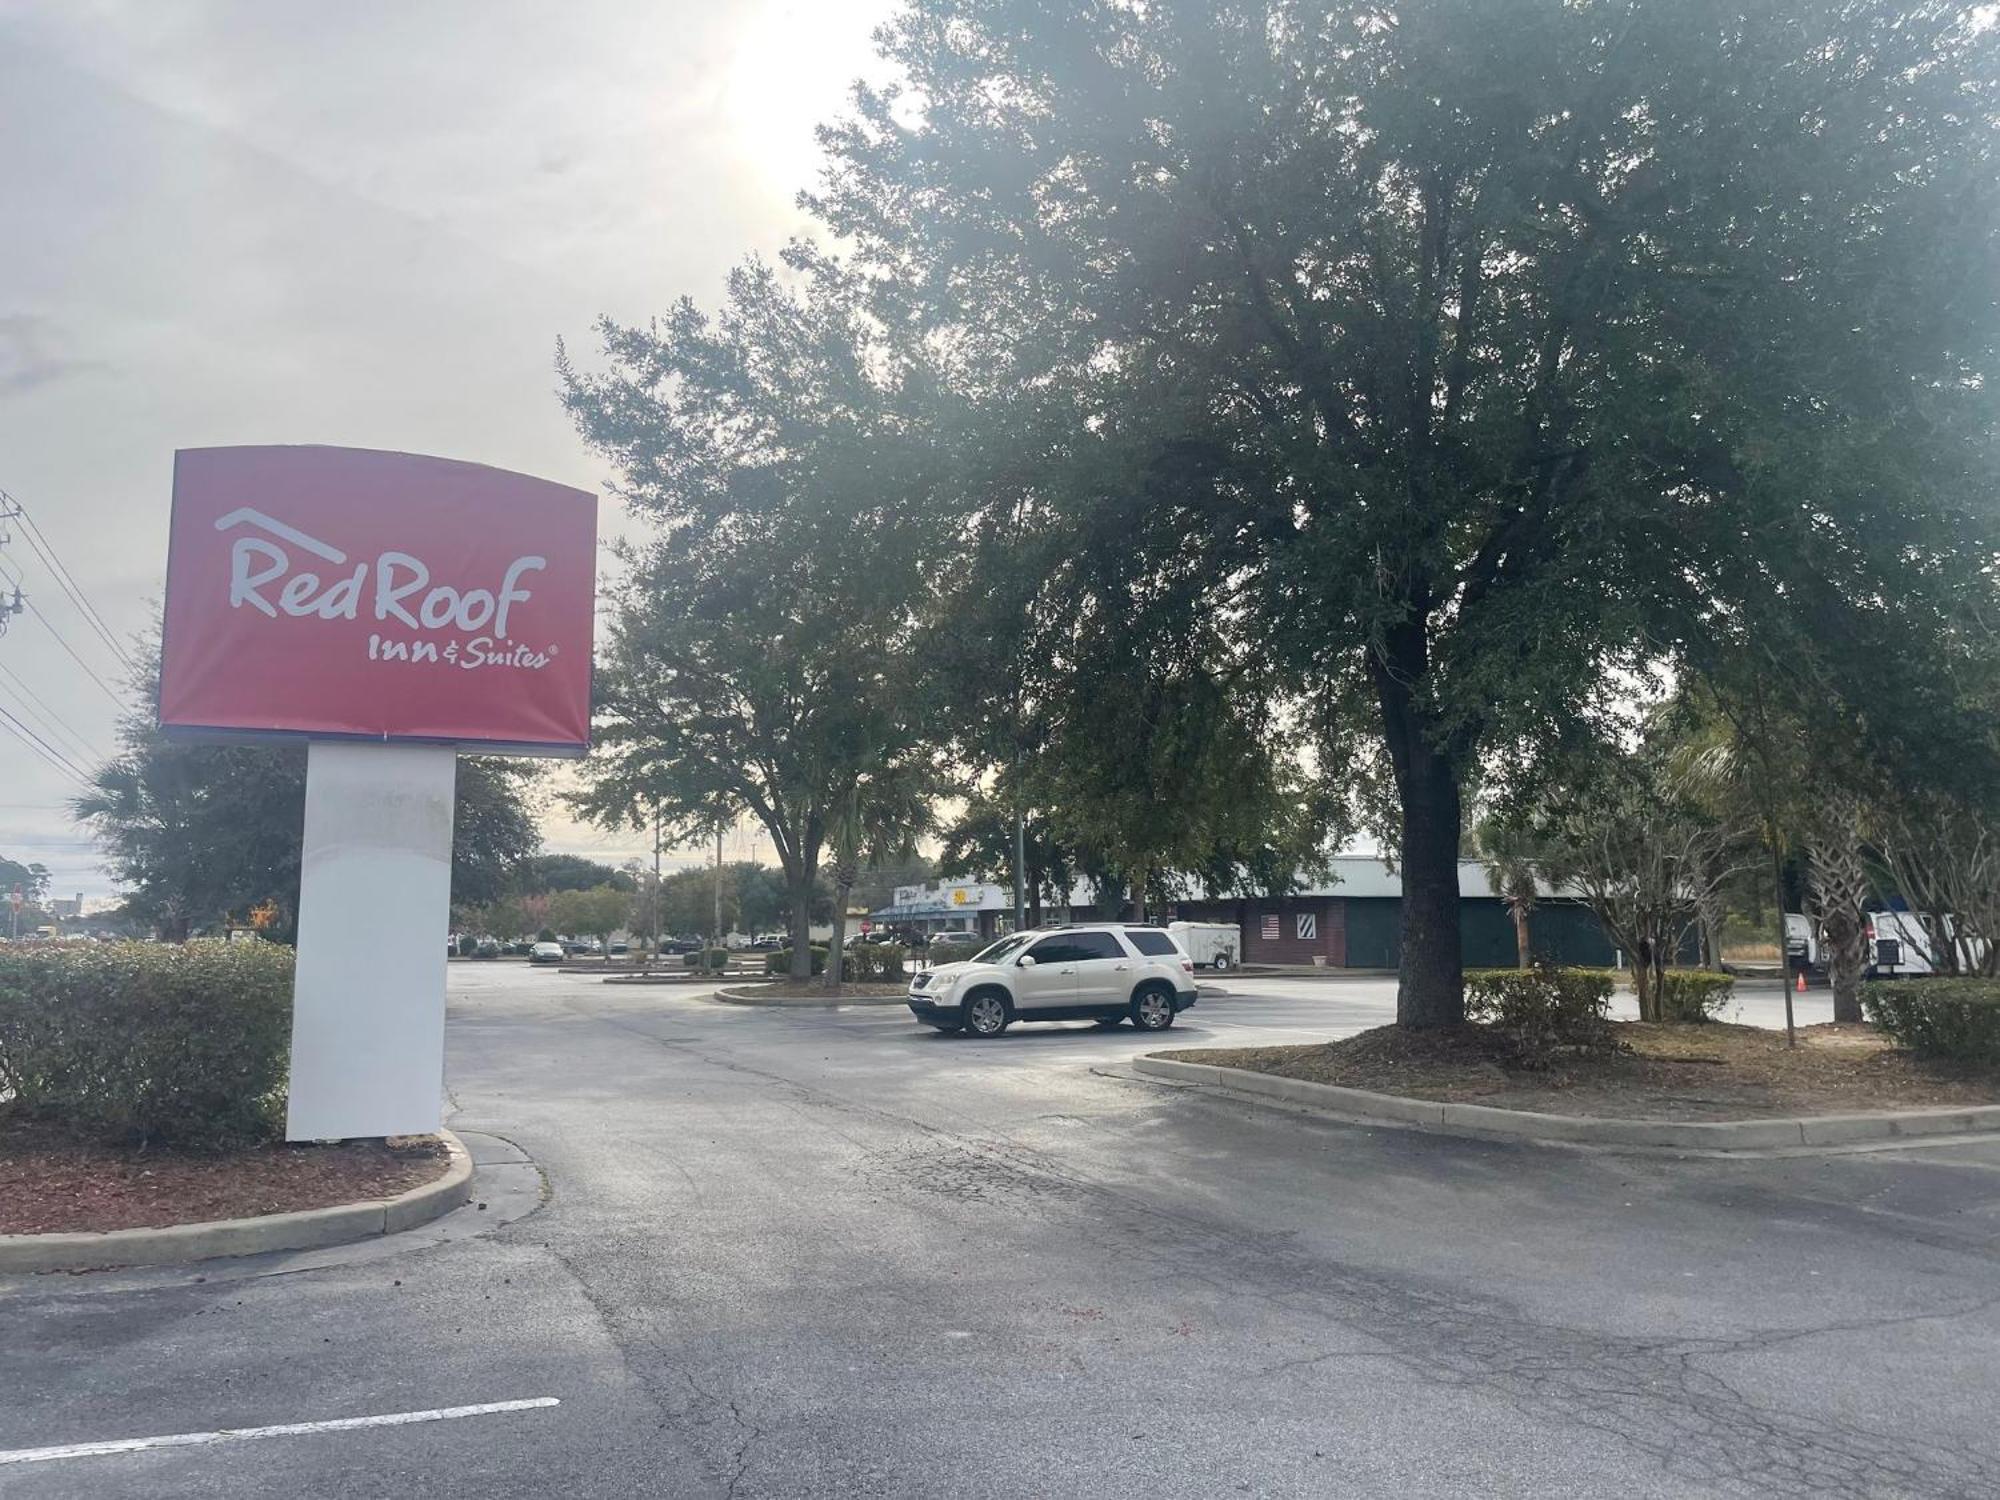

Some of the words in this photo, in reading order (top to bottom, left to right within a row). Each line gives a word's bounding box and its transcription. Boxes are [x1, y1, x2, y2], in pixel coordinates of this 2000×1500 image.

[231, 537, 368, 619] Red
[375, 551, 546, 639] Roof
[368, 634, 438, 663] Inn
[443, 640, 459, 664] &
